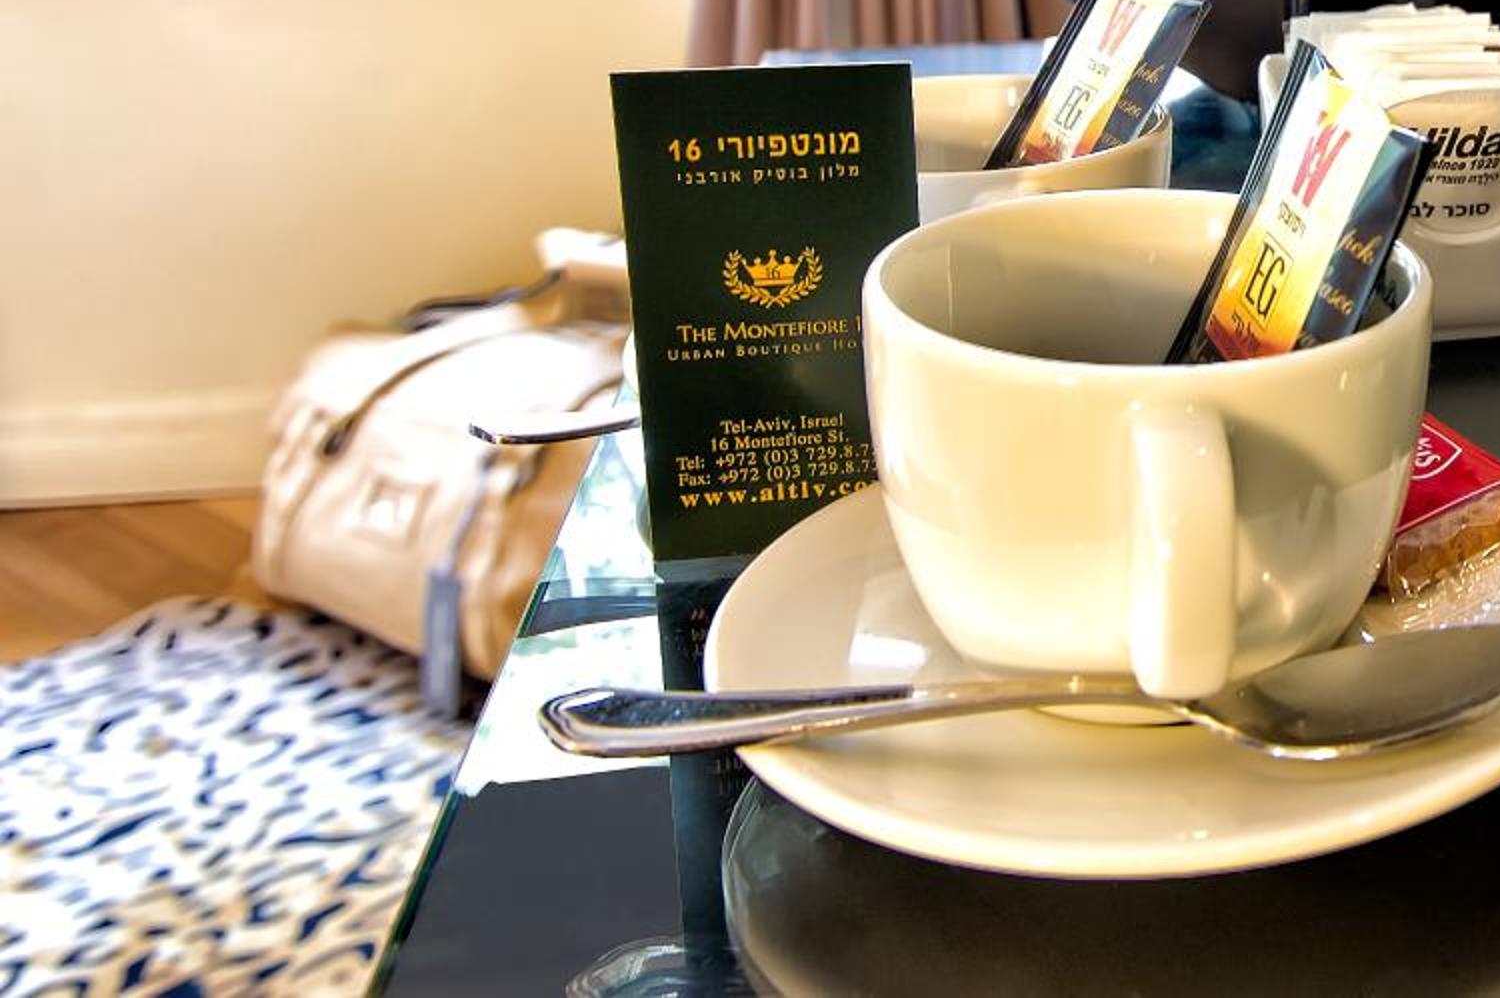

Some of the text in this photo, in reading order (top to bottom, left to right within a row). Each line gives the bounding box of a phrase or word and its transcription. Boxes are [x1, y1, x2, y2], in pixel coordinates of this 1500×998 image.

[669, 131, 861, 163] מונטפיורי 16
[677, 163, 860, 185] מלון בוטיק אורבני
[1409, 201, 1491, 219] סוכר לב
[1245, 242, 1286, 319] EG
[720, 412, 844, 435] Tel-Aviv, Israel
[711, 429, 850, 452] 16 Montefiore St.
[675, 455, 706, 471] Tel:
[716, 450, 758, 468] +972
[764, 448, 799, 467] (0)3
[678, 472, 712, 488] Fax:
[718, 467, 762, 484] +972
[767, 464, 801, 481] (0)3
[680, 480, 869, 509] www.altlv.co
